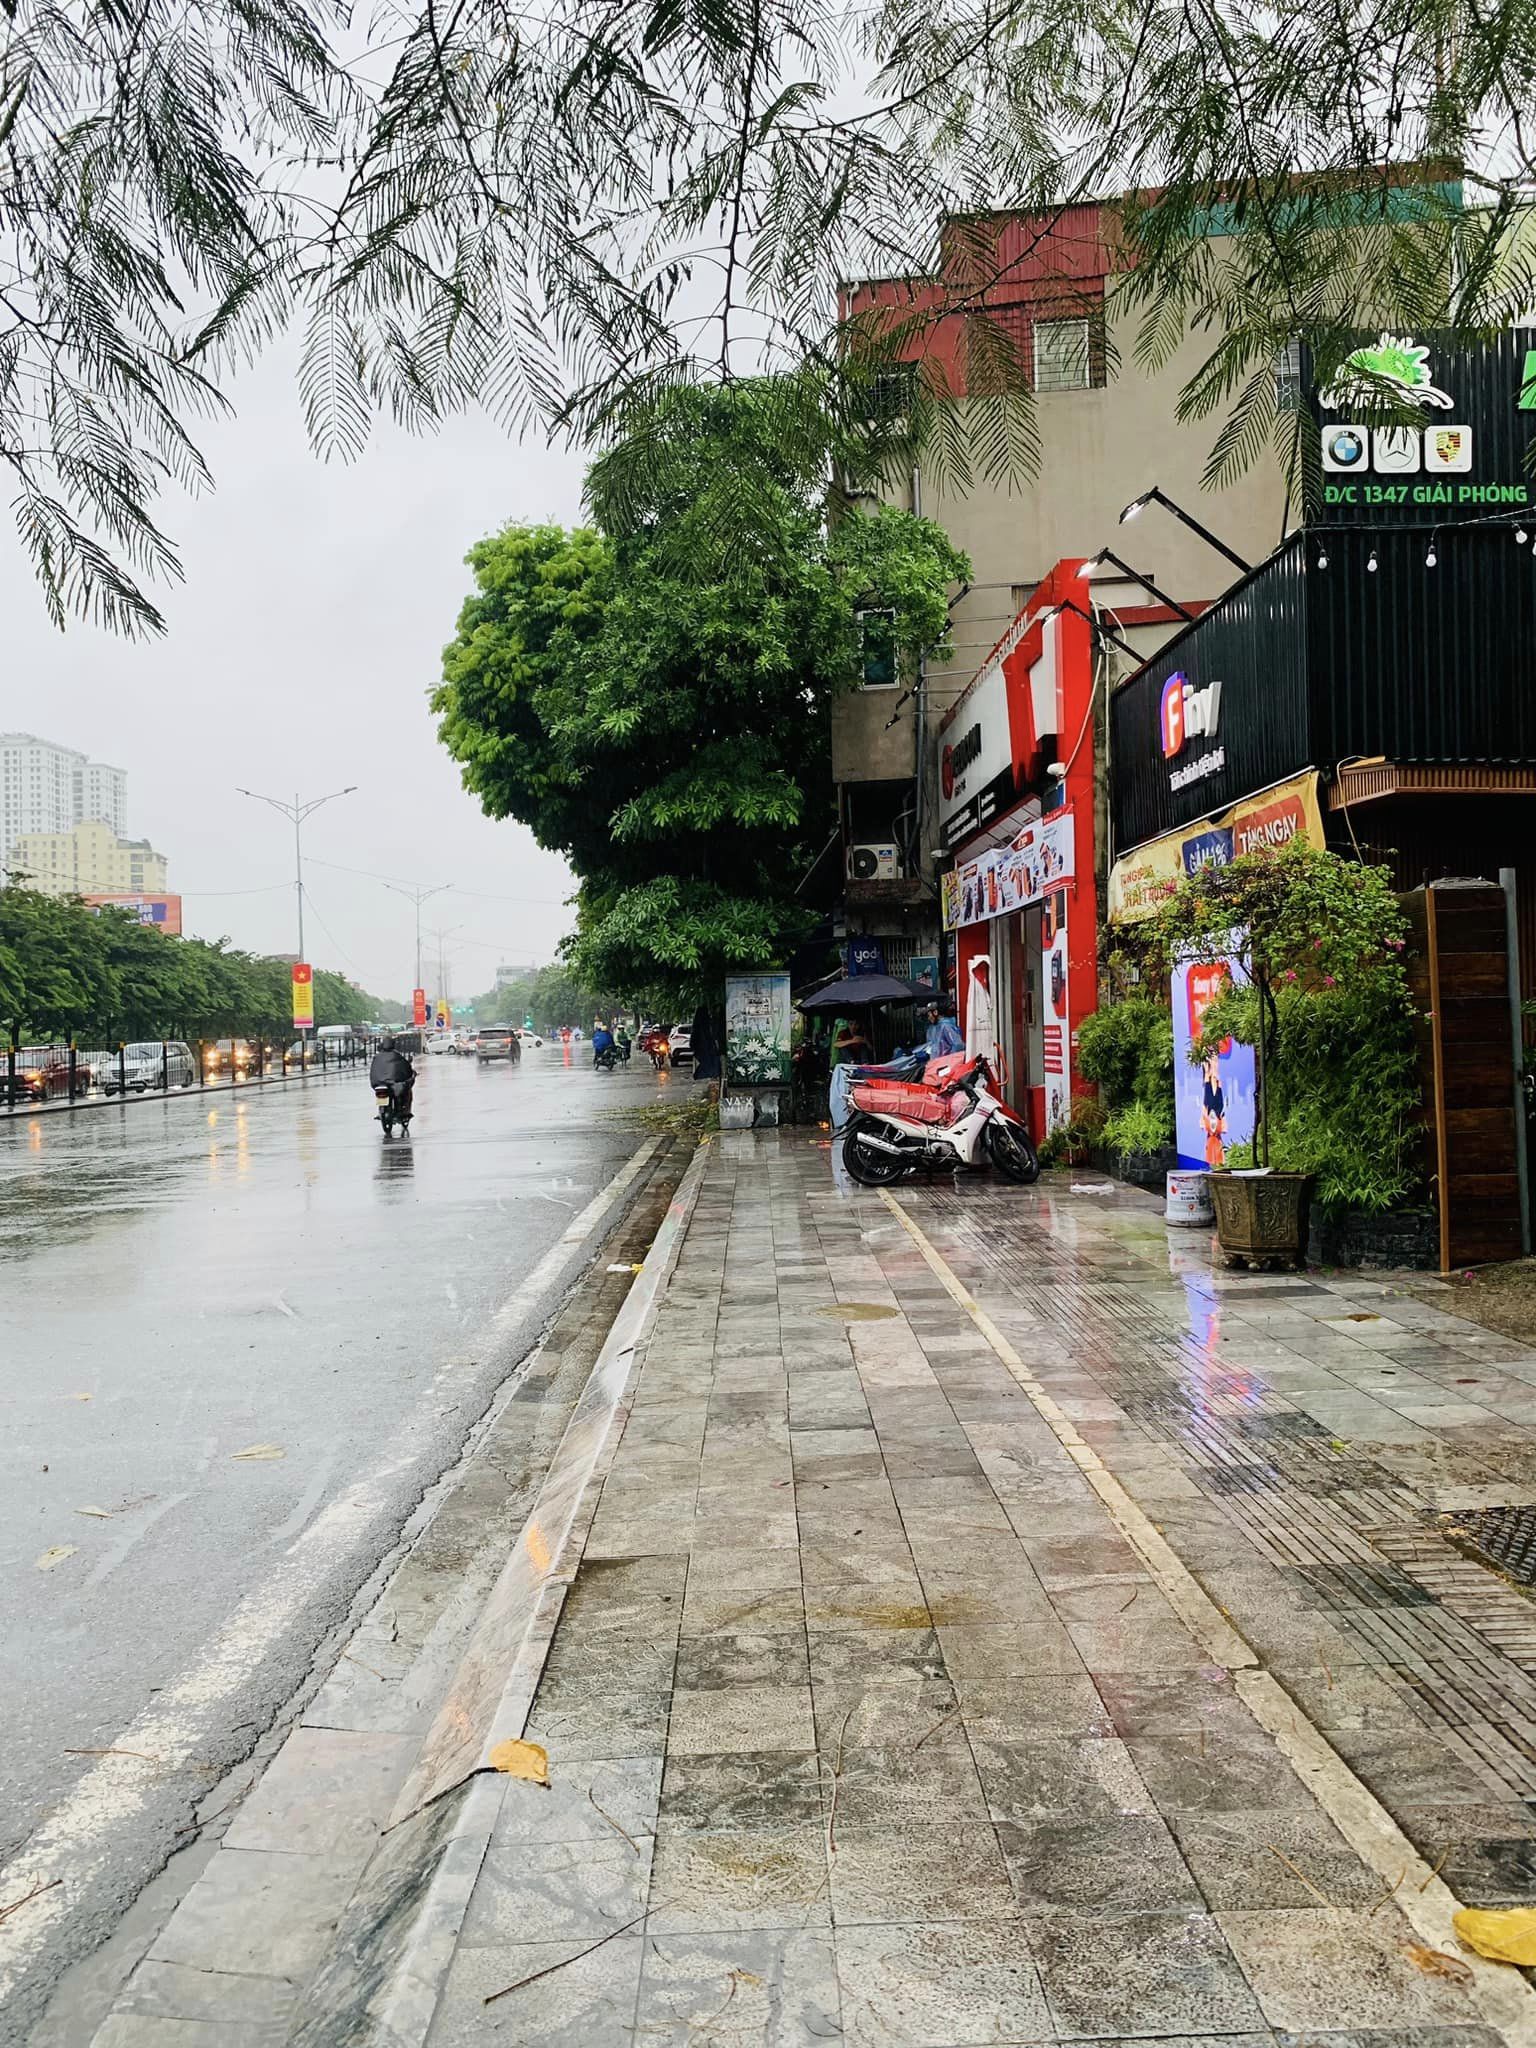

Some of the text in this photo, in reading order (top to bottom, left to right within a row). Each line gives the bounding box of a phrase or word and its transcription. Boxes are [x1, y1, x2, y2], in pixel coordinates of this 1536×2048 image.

[1324, 480, 1528, 503] Đ/C 1347 GIẢI PHÓNG
[1167, 681, 1222, 750] Finy
[1265, 813, 1298, 845] NGAY
